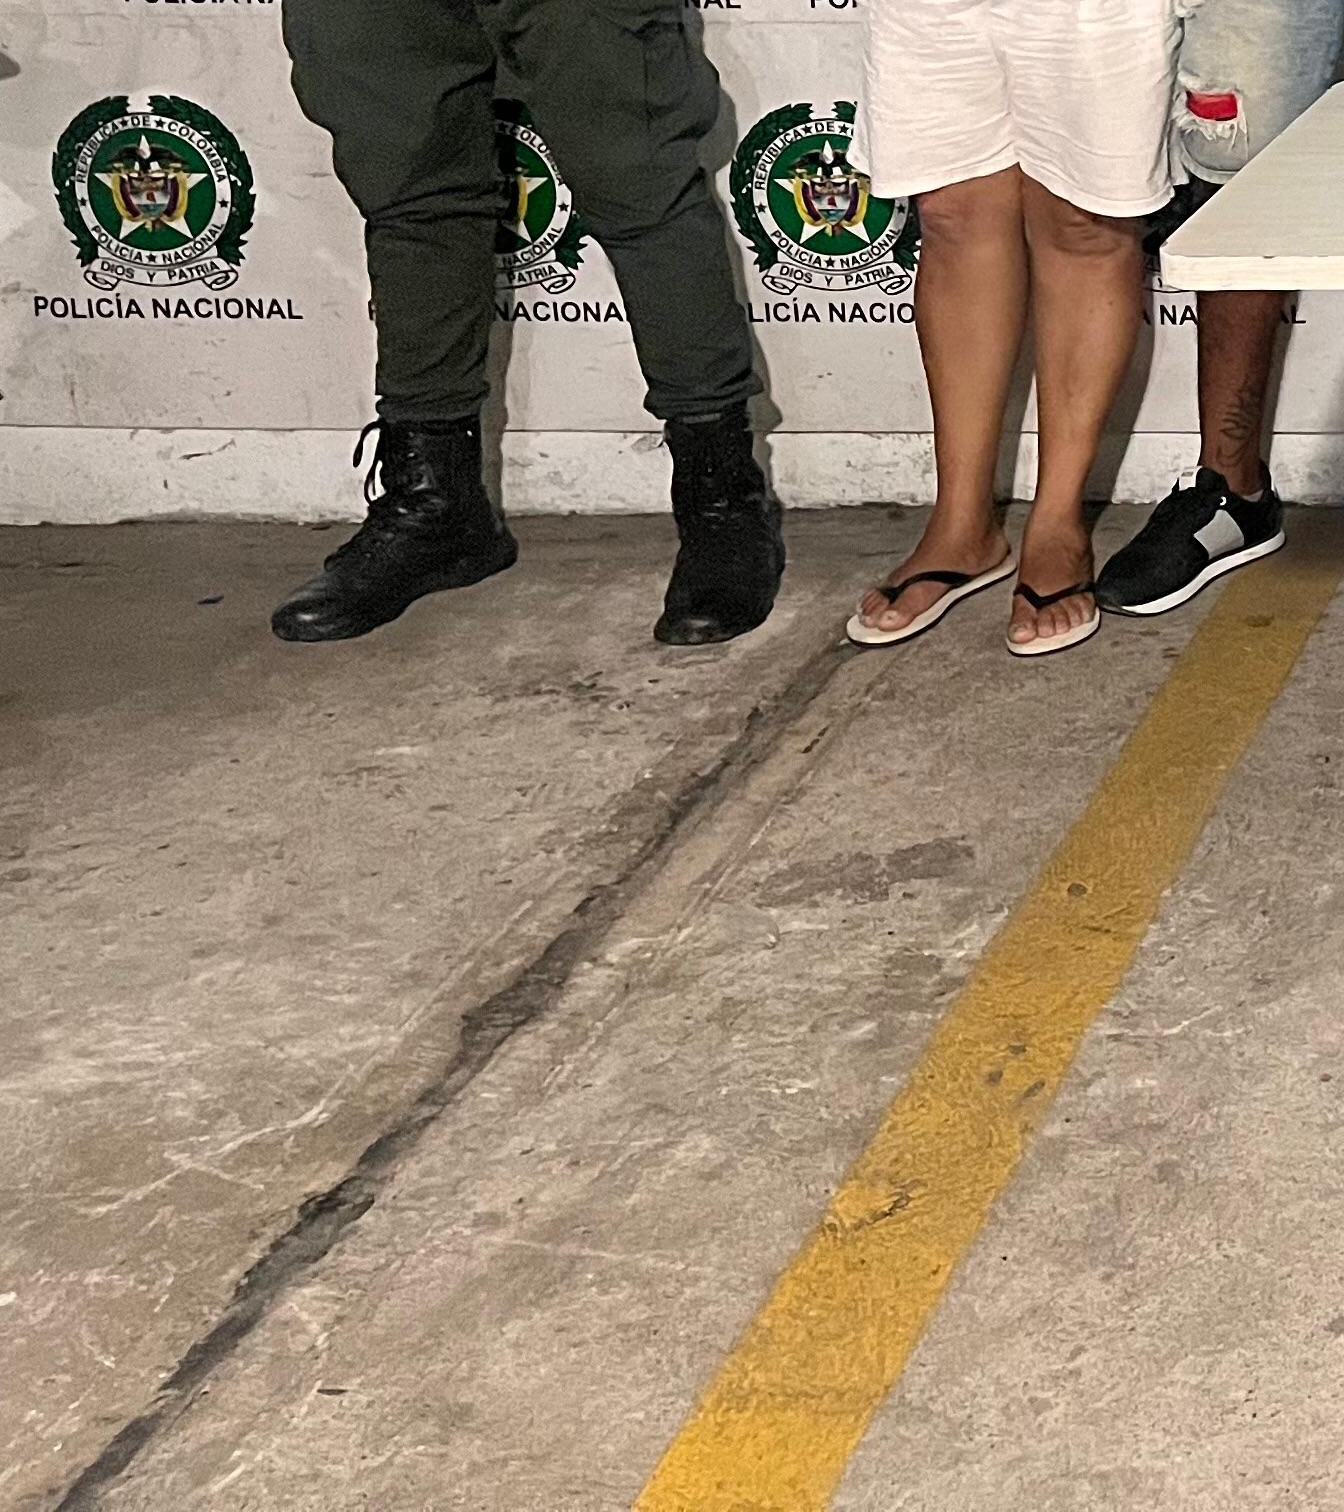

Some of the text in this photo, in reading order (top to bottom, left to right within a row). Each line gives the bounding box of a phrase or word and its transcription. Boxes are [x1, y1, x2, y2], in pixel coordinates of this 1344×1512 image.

[815, 123, 836, 133] DE
[132, 117, 152, 126] DE
[168, 121, 227, 183] COLOMBIA
[90, 225, 144, 262] POLICIA
[770, 230, 822, 267] POLICIA
[102, 261, 220, 282] DIOS Y PATRIA
[780, 266, 895, 285] DIOS PATRIA
[34, 293, 304, 318] POLICÍA NACIONAL
[496, 302, 623, 322] NACIONA
[748, 298, 916, 324] LICÍA NACIO
